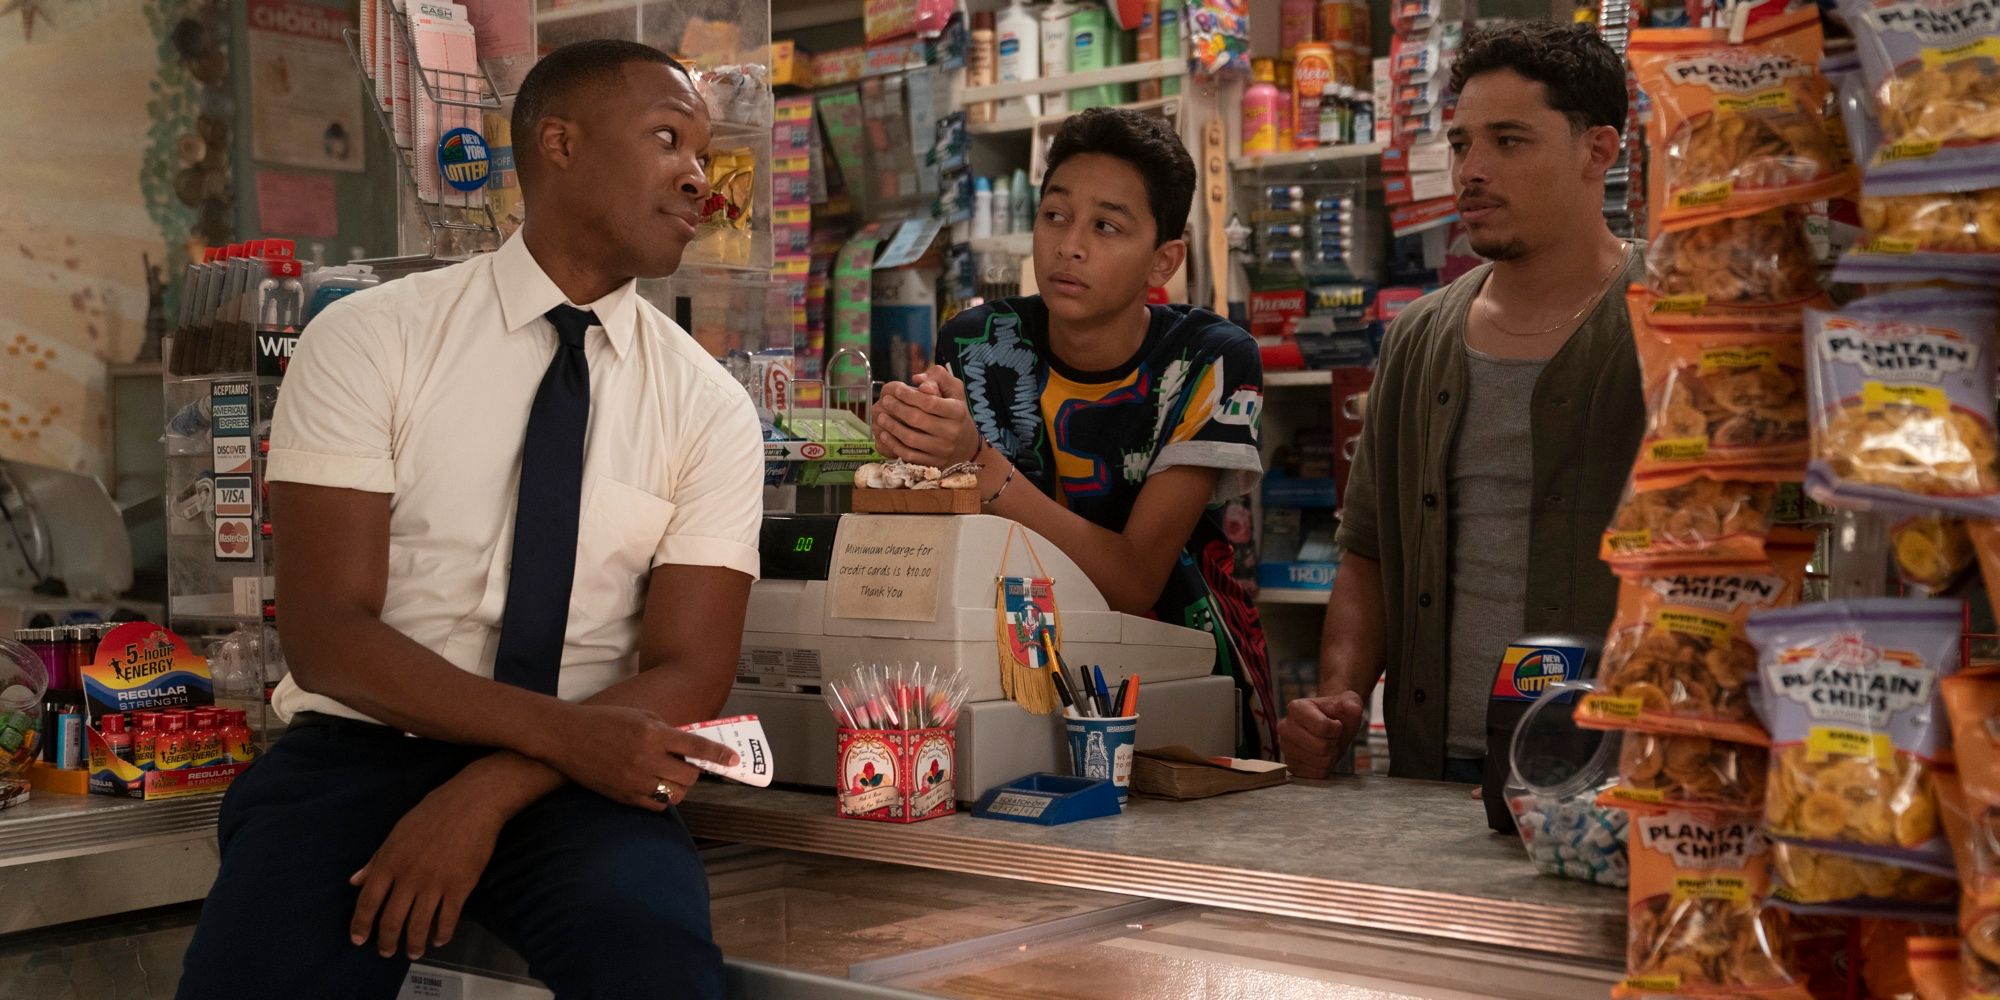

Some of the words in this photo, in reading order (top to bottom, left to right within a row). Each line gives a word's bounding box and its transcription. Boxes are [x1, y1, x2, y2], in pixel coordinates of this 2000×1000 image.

[420, 5, 453, 20] CASH
[1708, 70, 1779, 88] CHIPS
[461, 133, 480, 145] NEW
[465, 145, 487, 160] YORK
[444, 159, 489, 182] LOTTERY
[1252, 296, 1302, 312] TYLENOL
[1319, 288, 1364, 307] Advil
[1828, 336, 1969, 363] PLANTAIN
[213, 383, 249, 396] ACEPTAMOS
[212, 404, 248, 417] AMERICAN
[219, 417, 250, 429] EXPRESS
[216, 445, 247, 455] DISCOVER
[221, 489, 245, 503] VISA
[219, 534, 249, 543] MasterCard
[844, 543, 884, 556] Minimum
[884, 544, 915, 557] charge
[916, 543, 934, 557] for
[839, 564, 866, 576] credit
[867, 565, 891, 577] cards
[892, 565, 901, 577] is
[905, 566, 932, 578] $10.00
[860, 585, 886, 599] Thank
[887, 585, 904, 599] You
[1652, 574, 1774, 599] ANTAIN
[1667, 585, 1738, 603] CHIPS
[125, 643, 175, 665] 5-hour
[1543, 654, 1561, 663] NEW
[125, 657, 174, 681] ENERGY
[1543, 663, 1564, 675] YORK
[1780, 668, 1922, 696] PLANTAIN
[117, 685, 187, 701] REGULAR
[1811, 688, 1888, 712] CHIPS
[119, 696, 189, 710] STRENGTH
[188, 768, 235, 780] REGULAR
[1648, 823, 1775, 847] PLANTA
[1675, 842, 1745, 860] CHIPS
